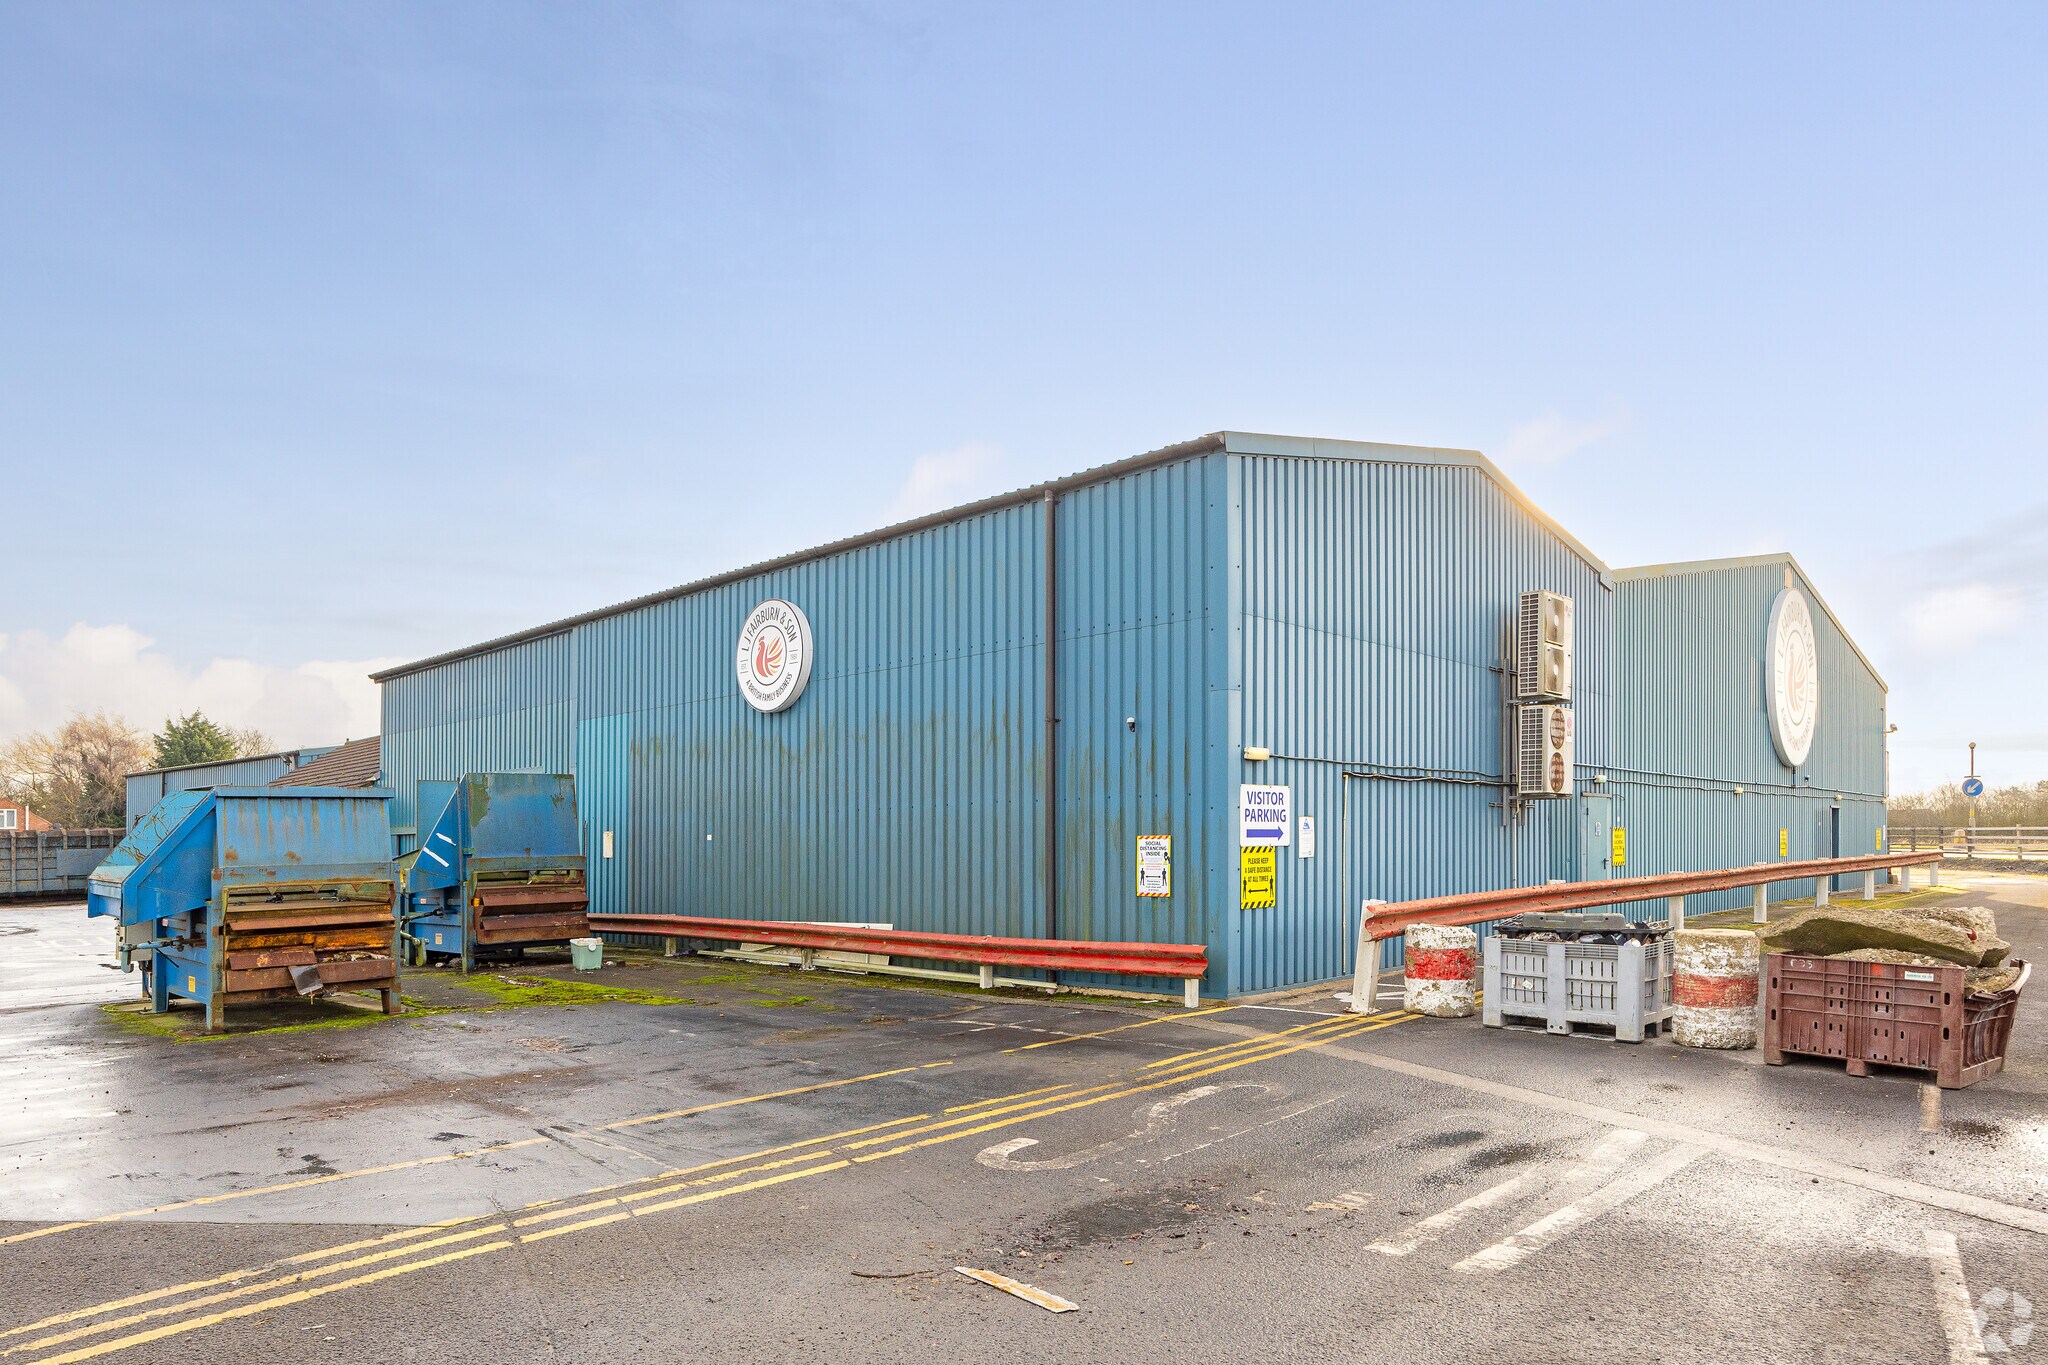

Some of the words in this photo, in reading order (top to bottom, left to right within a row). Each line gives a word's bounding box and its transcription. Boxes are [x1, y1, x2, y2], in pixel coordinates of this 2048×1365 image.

[747, 607, 781, 637] FAIRBURN
[779, 611, 787, 625] &
[784, 618, 797, 643] SON
[744, 636, 752, 645] J
[1247, 791, 1284, 806] VISITOR
[1245, 808, 1287, 823] PARKING
